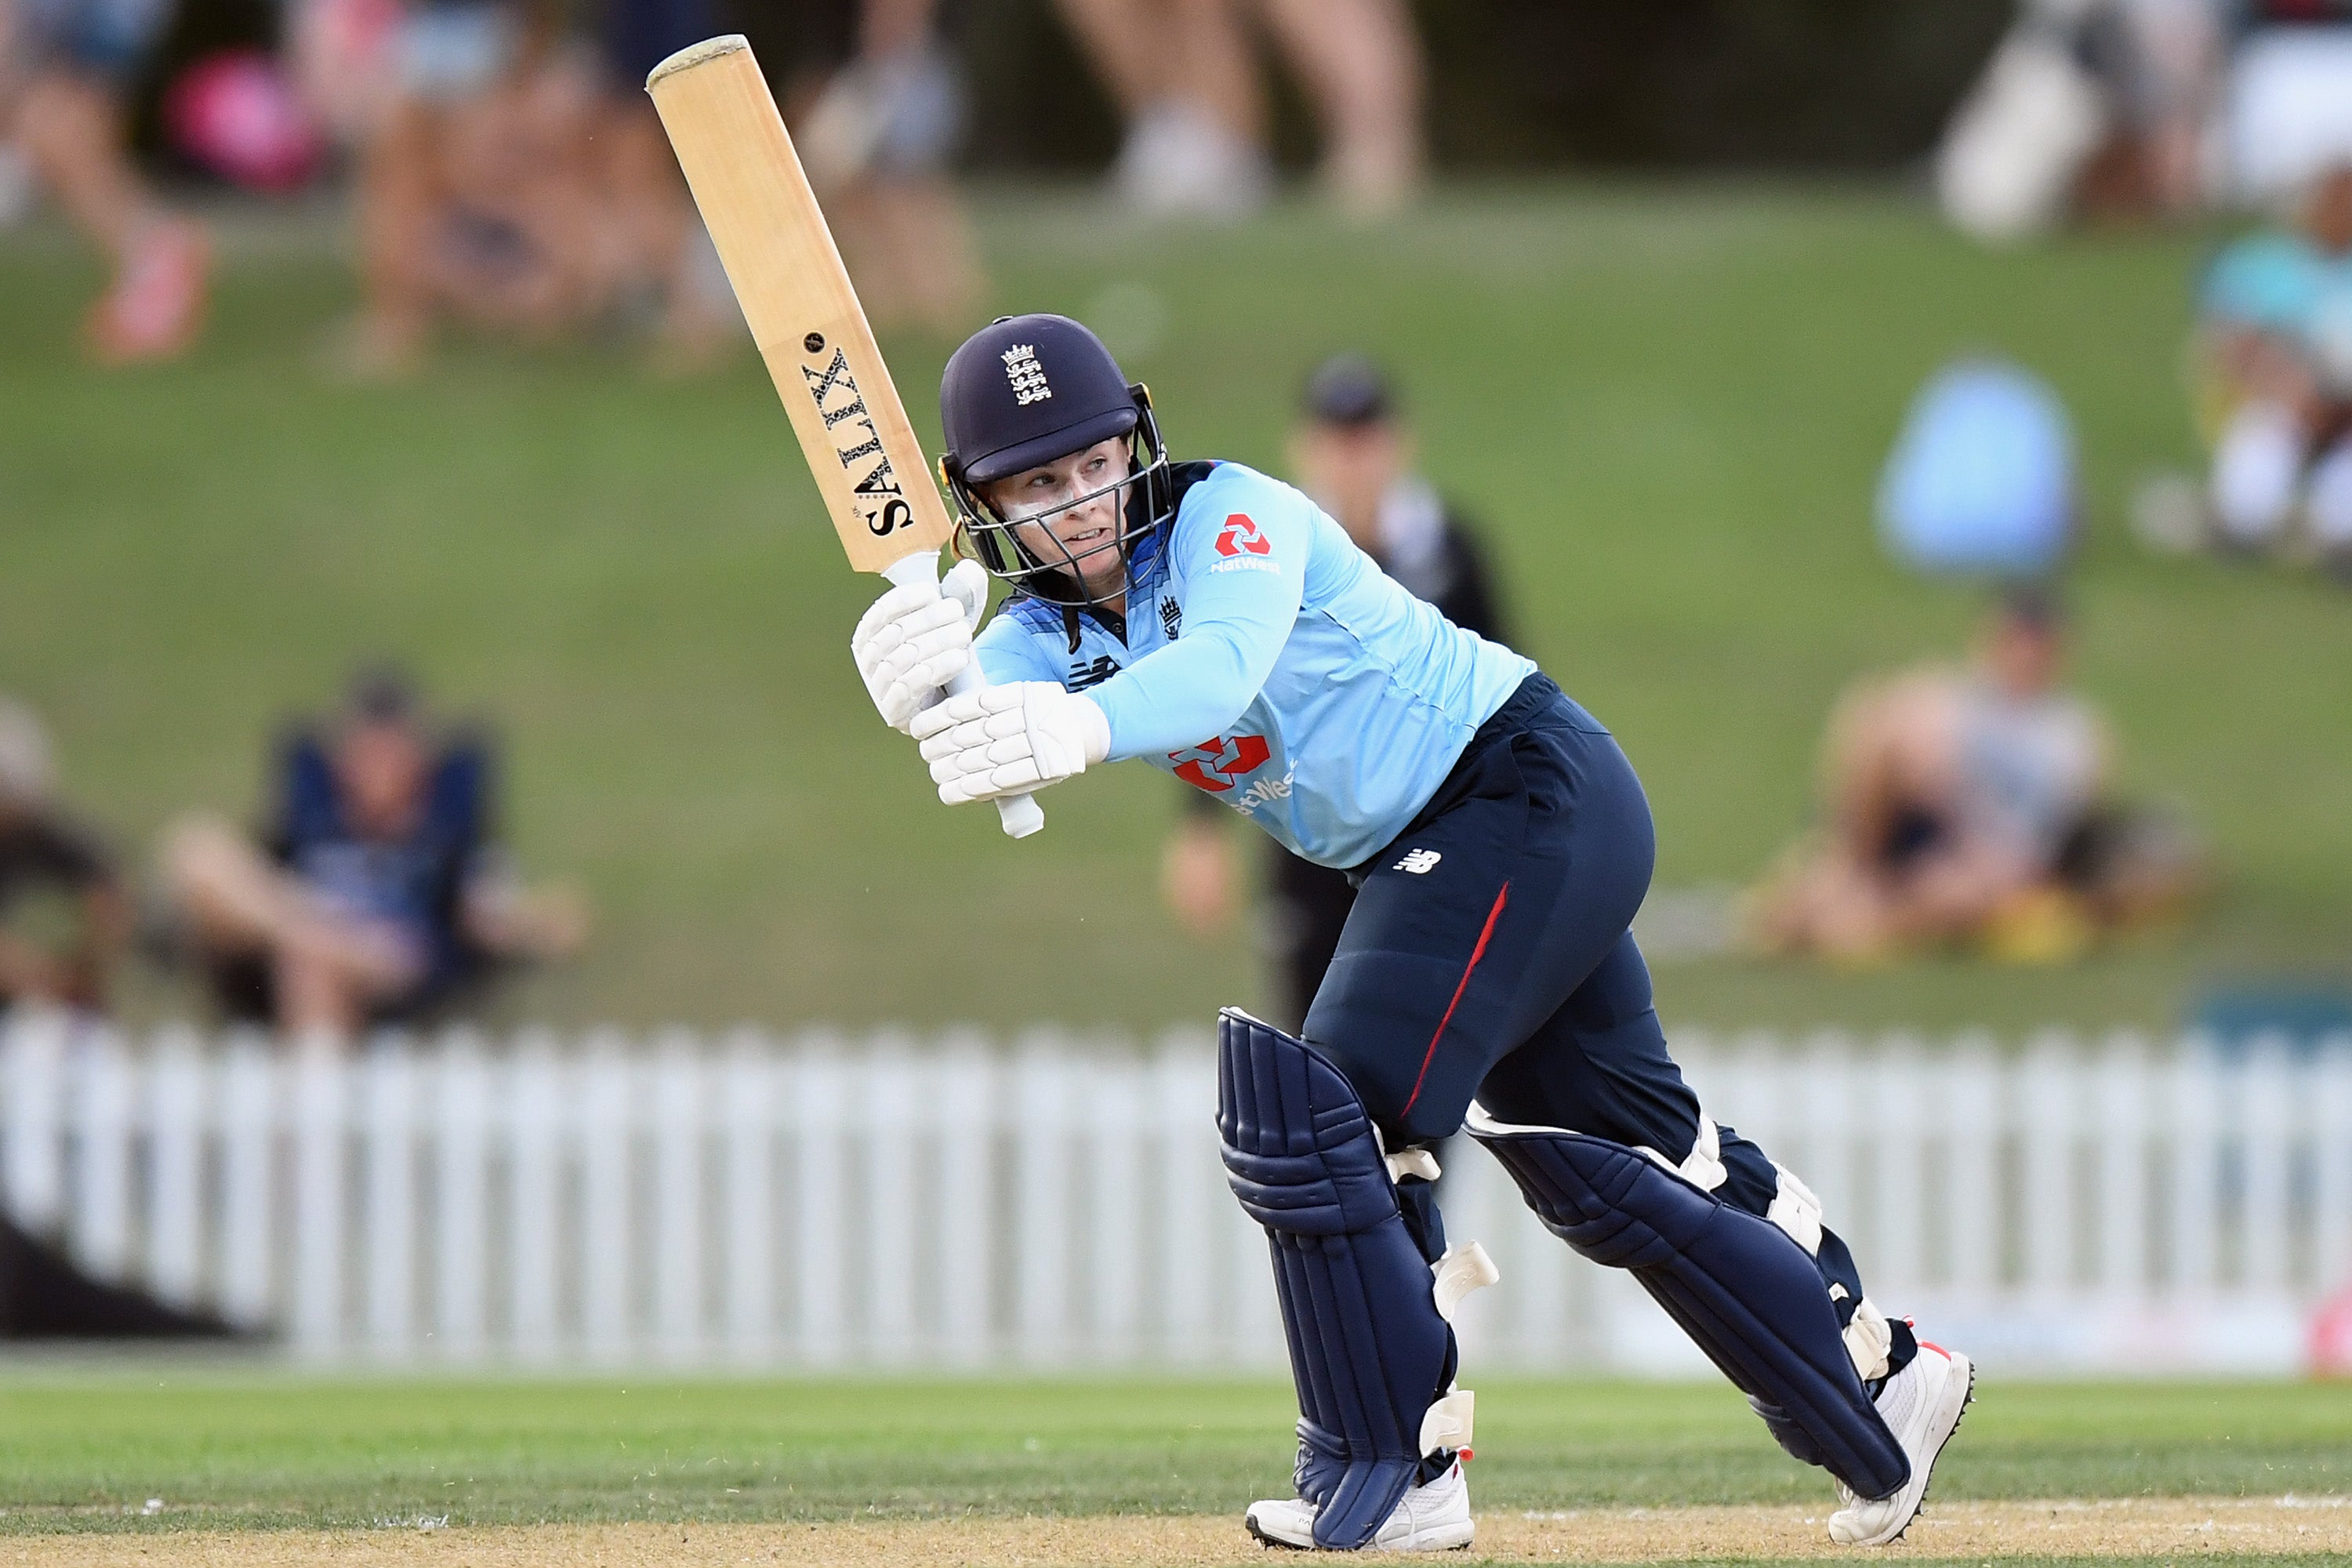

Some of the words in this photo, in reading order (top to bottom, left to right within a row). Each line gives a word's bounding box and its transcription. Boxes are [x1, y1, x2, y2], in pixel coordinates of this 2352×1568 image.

[801, 347, 913, 535] SALIX
[1210, 556, 1281, 575] NatWest
[1230, 757, 1298, 816] atWes
